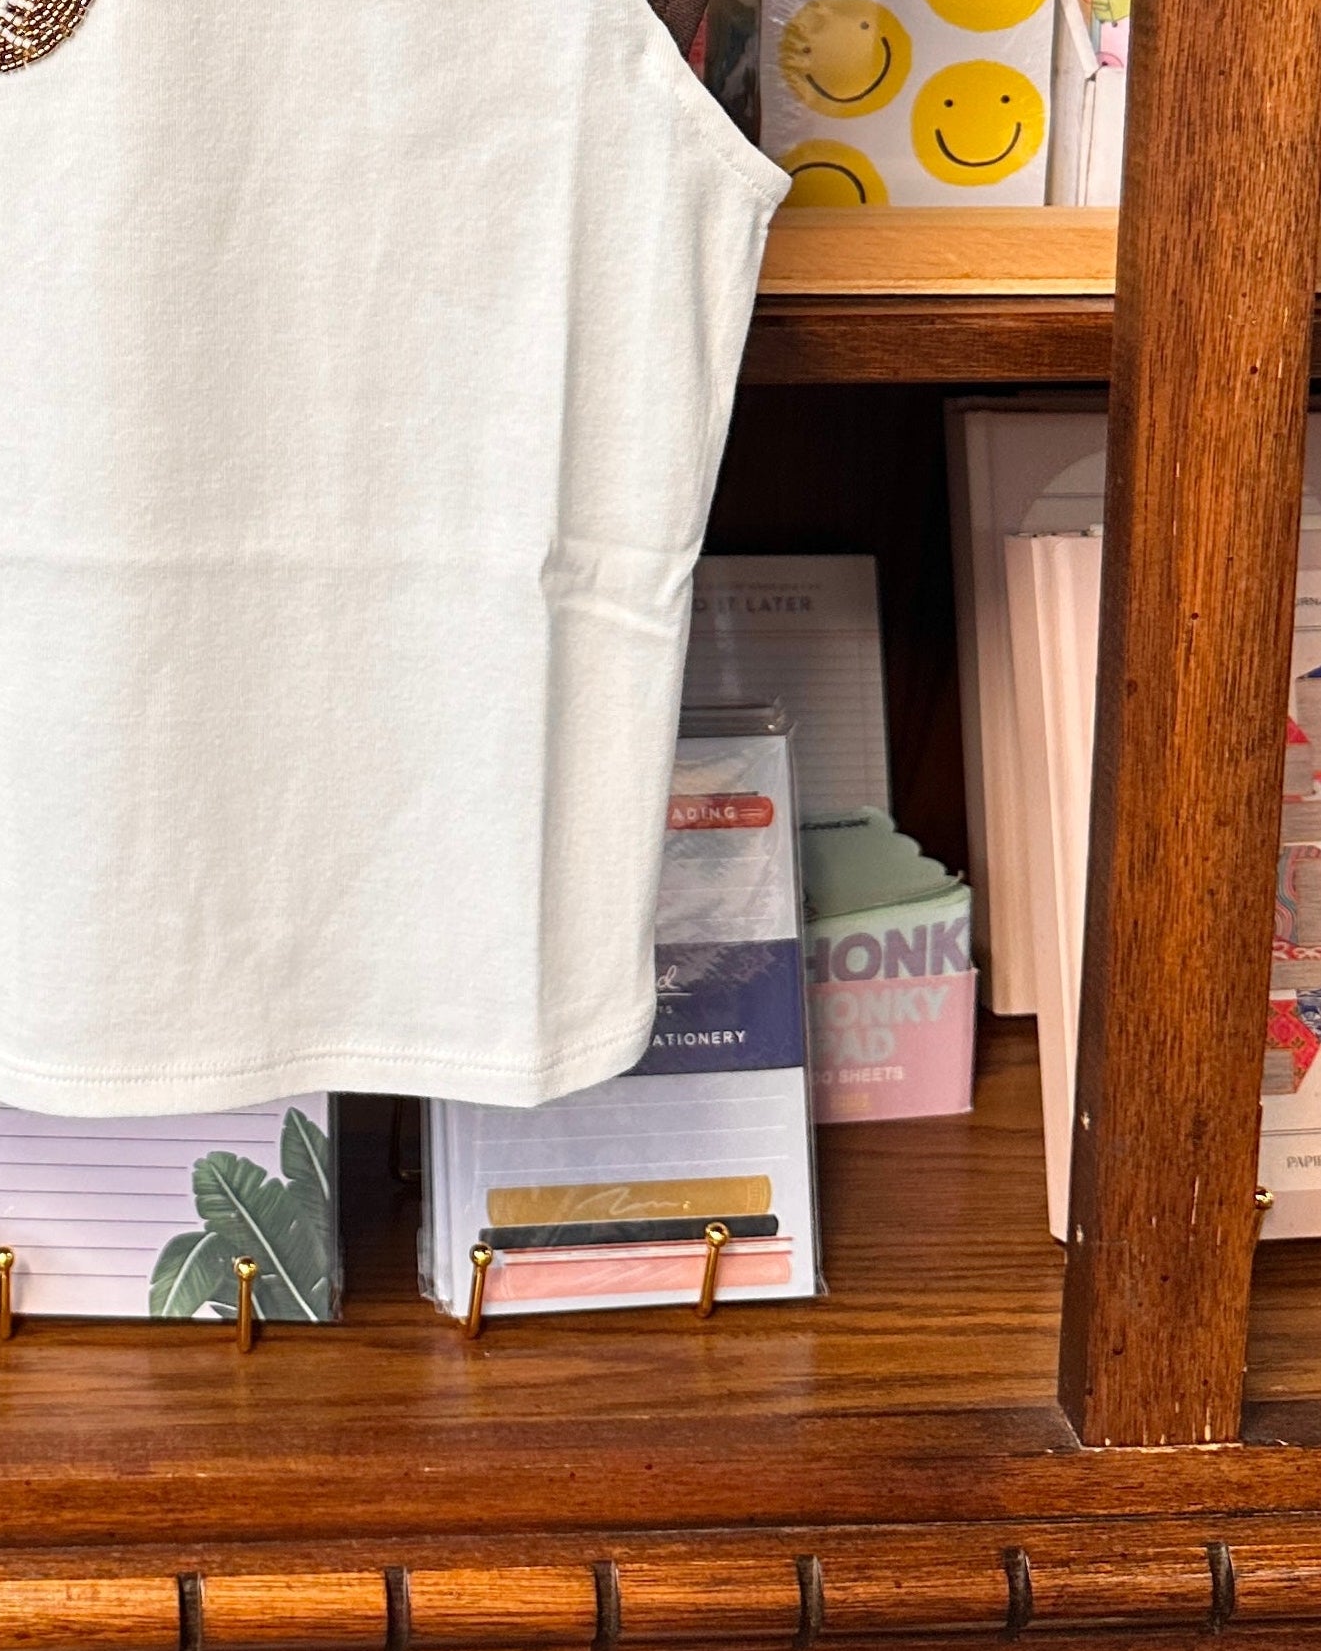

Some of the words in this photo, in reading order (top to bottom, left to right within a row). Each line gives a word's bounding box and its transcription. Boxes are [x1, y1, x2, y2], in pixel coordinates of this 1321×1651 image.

[746, 596, 811, 613] LATER
[651, 1029, 747, 1047] ATIONERY
[838, 1065, 904, 1085] SHEETS
